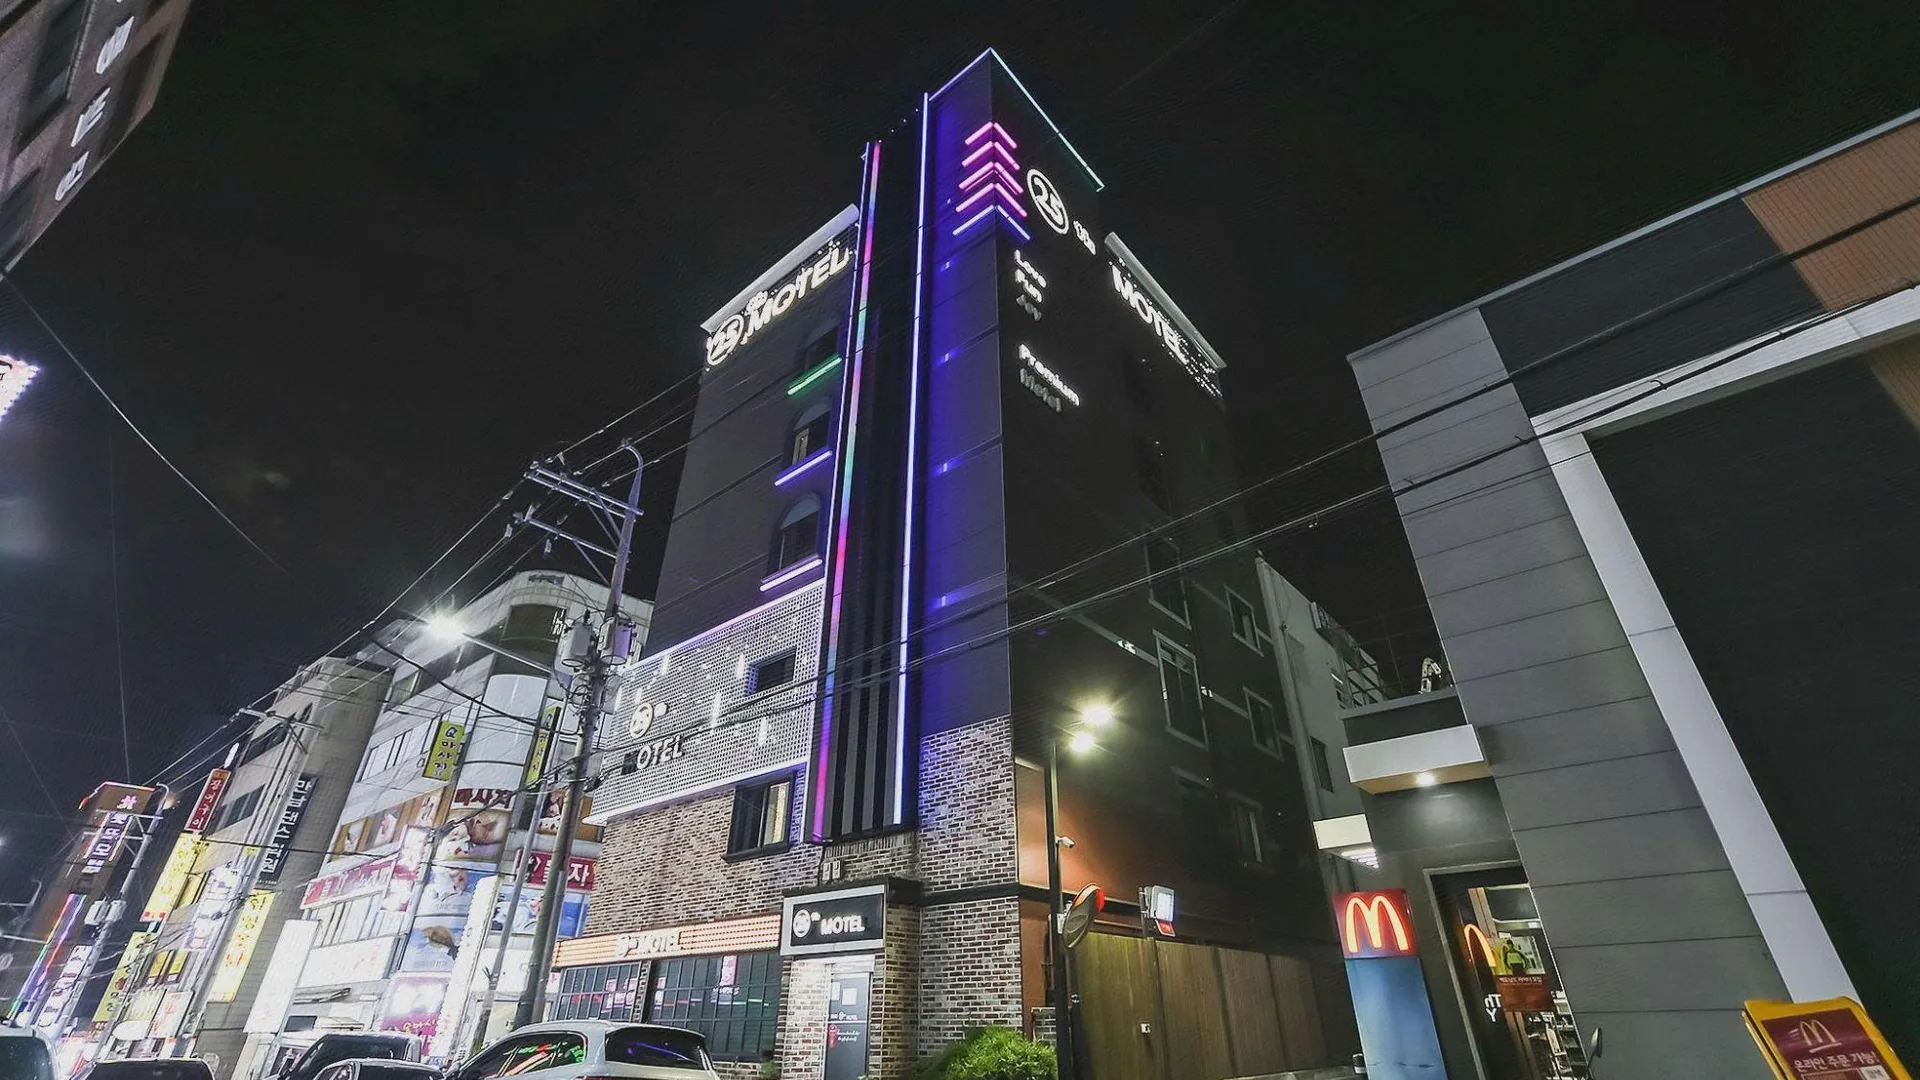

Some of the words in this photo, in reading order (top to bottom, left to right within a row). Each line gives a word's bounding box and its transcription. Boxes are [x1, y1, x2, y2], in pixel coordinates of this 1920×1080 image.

[742, 247, 850, 344] MOTEL
[821, 915, 866, 936] MOTEL
[1794, 1057, 1825, 1072] 온라인
[1828, 1054, 1851, 1068] 주문
[1852, 1051, 1880, 1064] 가능!
